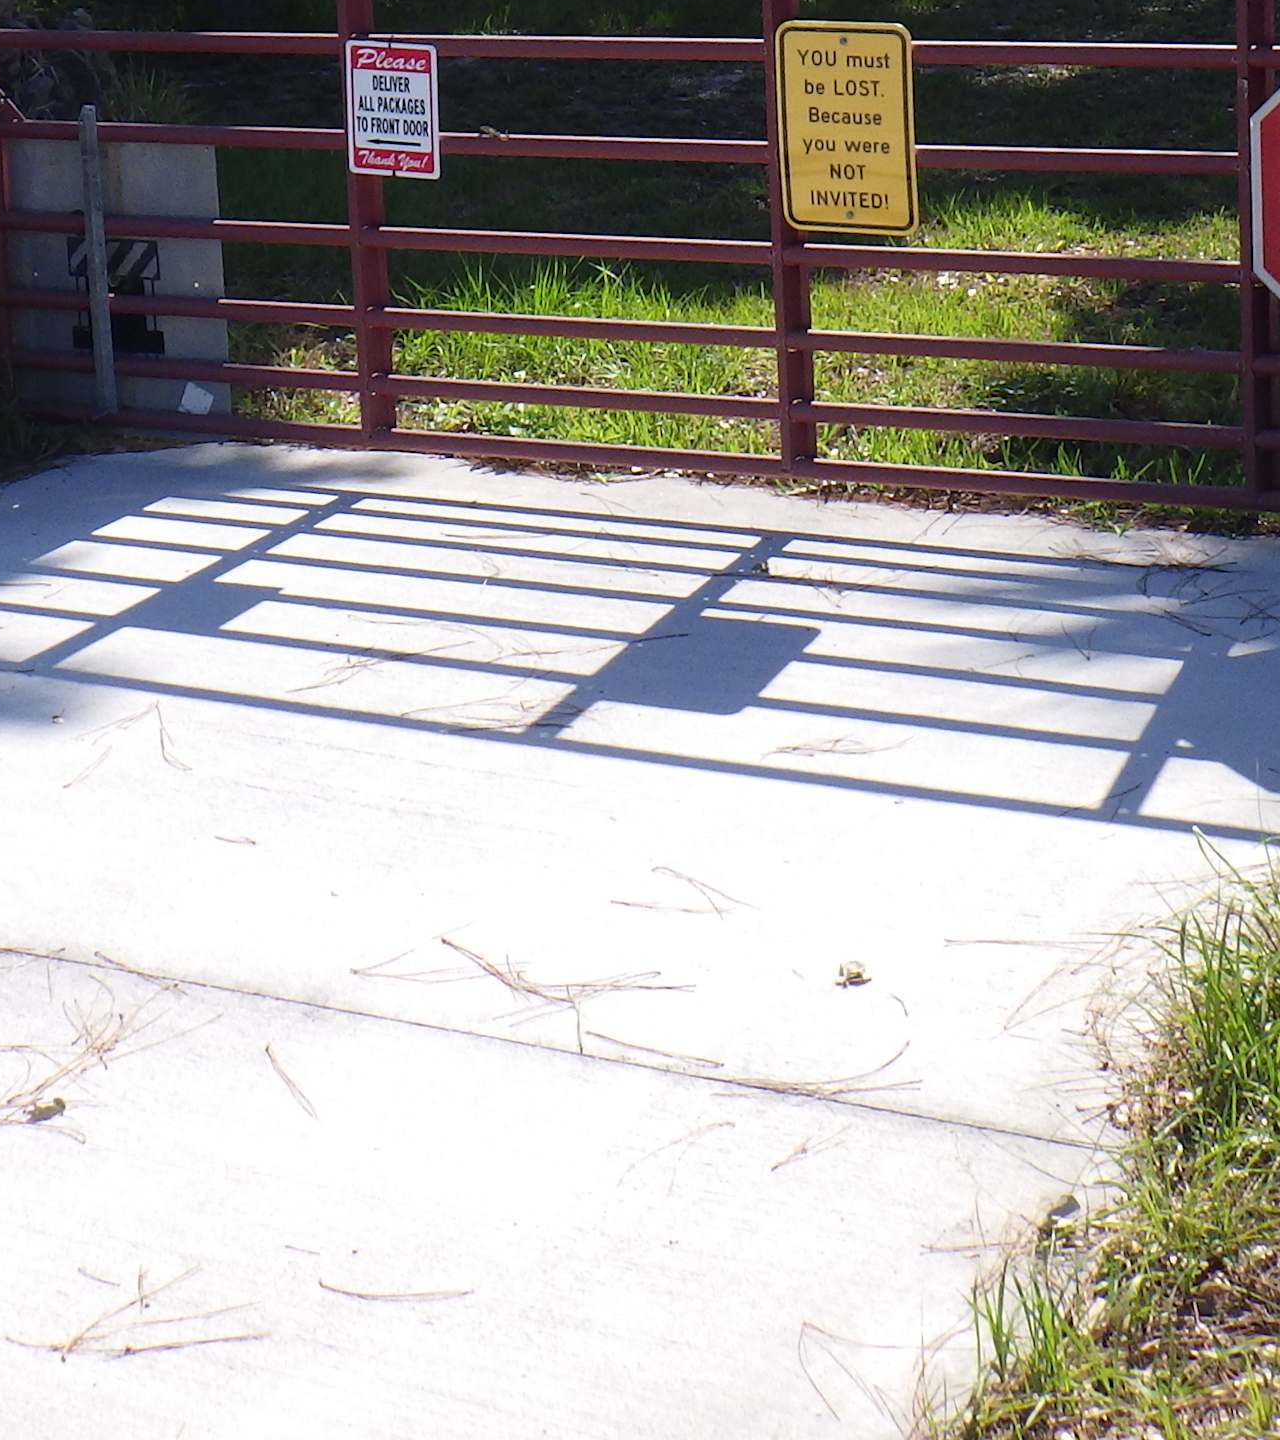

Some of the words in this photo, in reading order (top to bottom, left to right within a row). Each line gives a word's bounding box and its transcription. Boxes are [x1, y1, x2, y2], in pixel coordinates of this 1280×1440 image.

[356, 48, 426, 70] Please
[797, 49, 837, 66] YOU
[846, 53, 890, 69] must
[372, 75, 410, 93] DELIVER
[804, 79, 825, 95] be
[834, 79, 885, 97] LOST.
[358, 96, 375, 112] ALL
[377, 97, 426, 115] PACKAGES
[808, 107, 882, 125] Because
[356, 117, 369, 133] TO
[371, 118, 400, 135] FRONT
[403, 120, 429, 137] DOOR
[802, 138, 836, 154] you
[844, 139, 890, 154] were
[358, 150, 395, 168] Thank
[397, 152, 427, 171] You!
[830, 164, 866, 180] NOT
[810, 190, 889, 210] INVITED!
